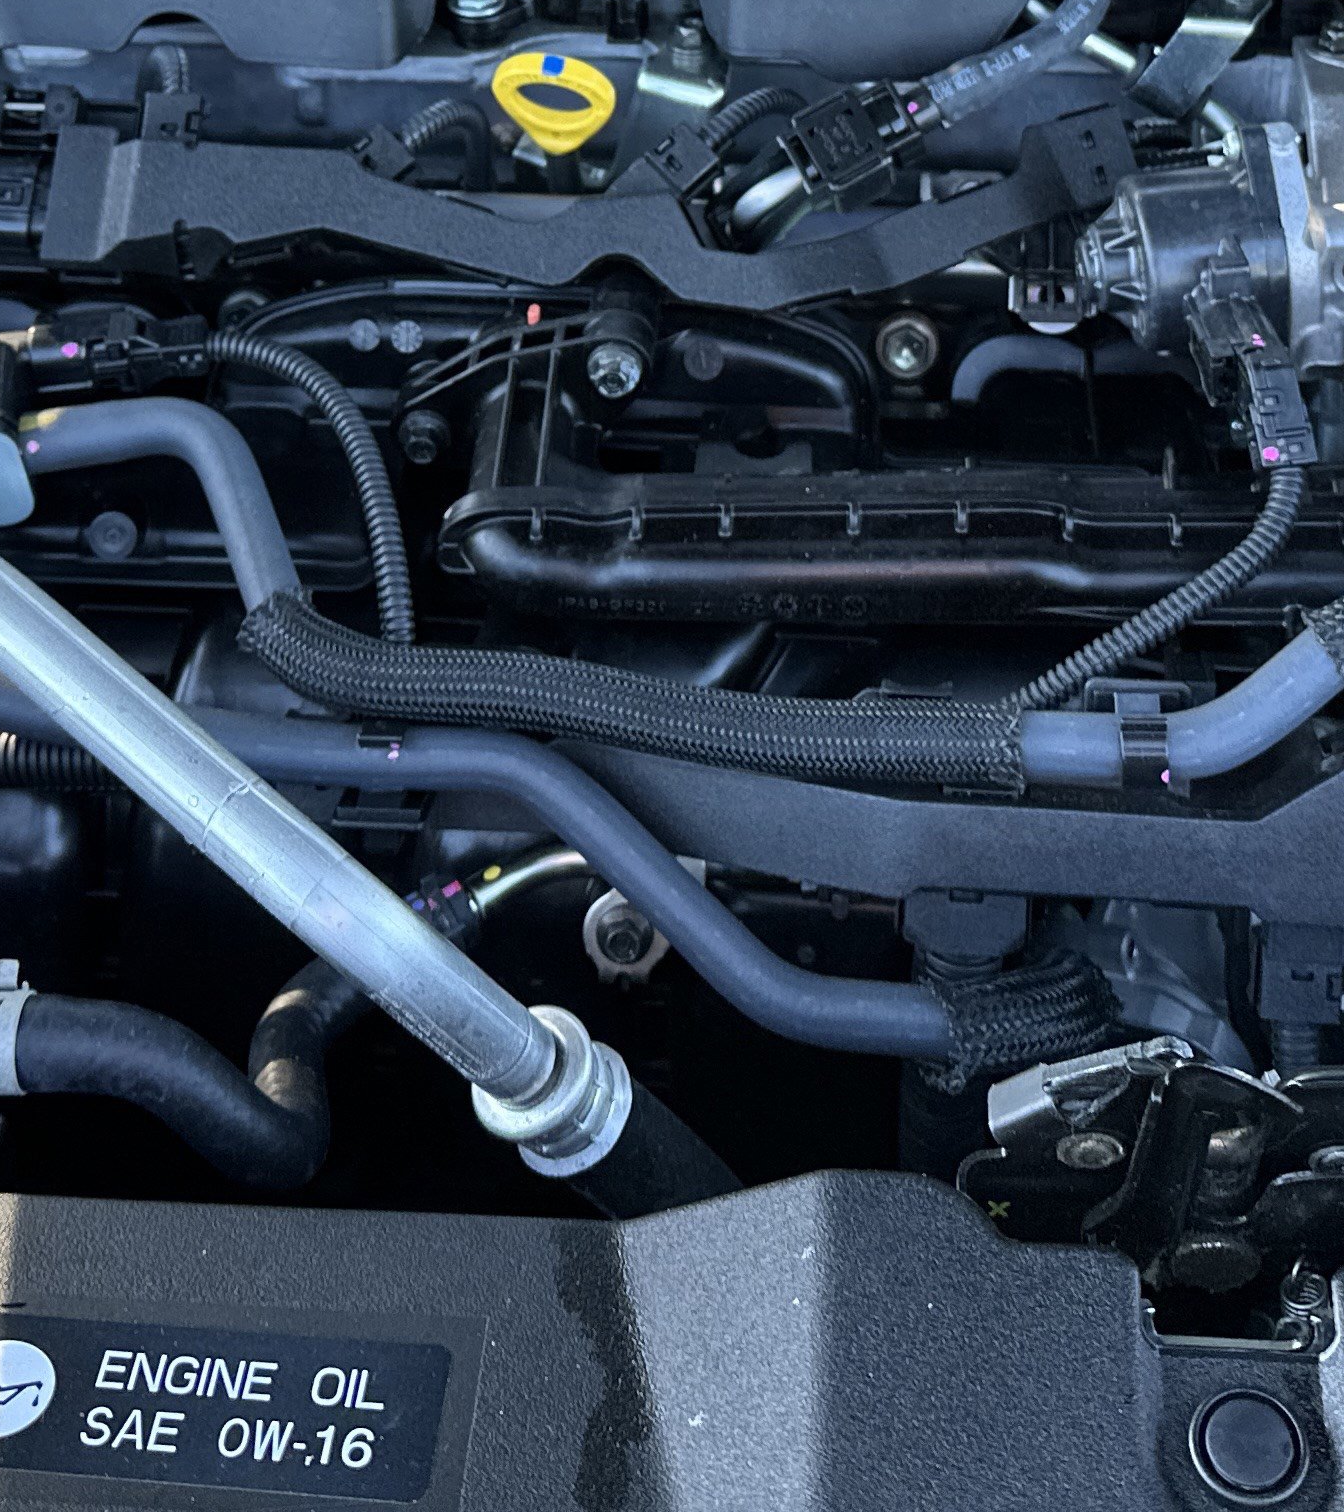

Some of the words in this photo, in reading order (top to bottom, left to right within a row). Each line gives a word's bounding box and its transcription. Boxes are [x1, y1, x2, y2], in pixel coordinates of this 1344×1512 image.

[94, 1349, 279, 1403] ENGINE
[311, 1365, 385, 1411] OIL
[79, 1406, 185, 1454] SAE
[217, 1417, 376, 1470] 0W-16
